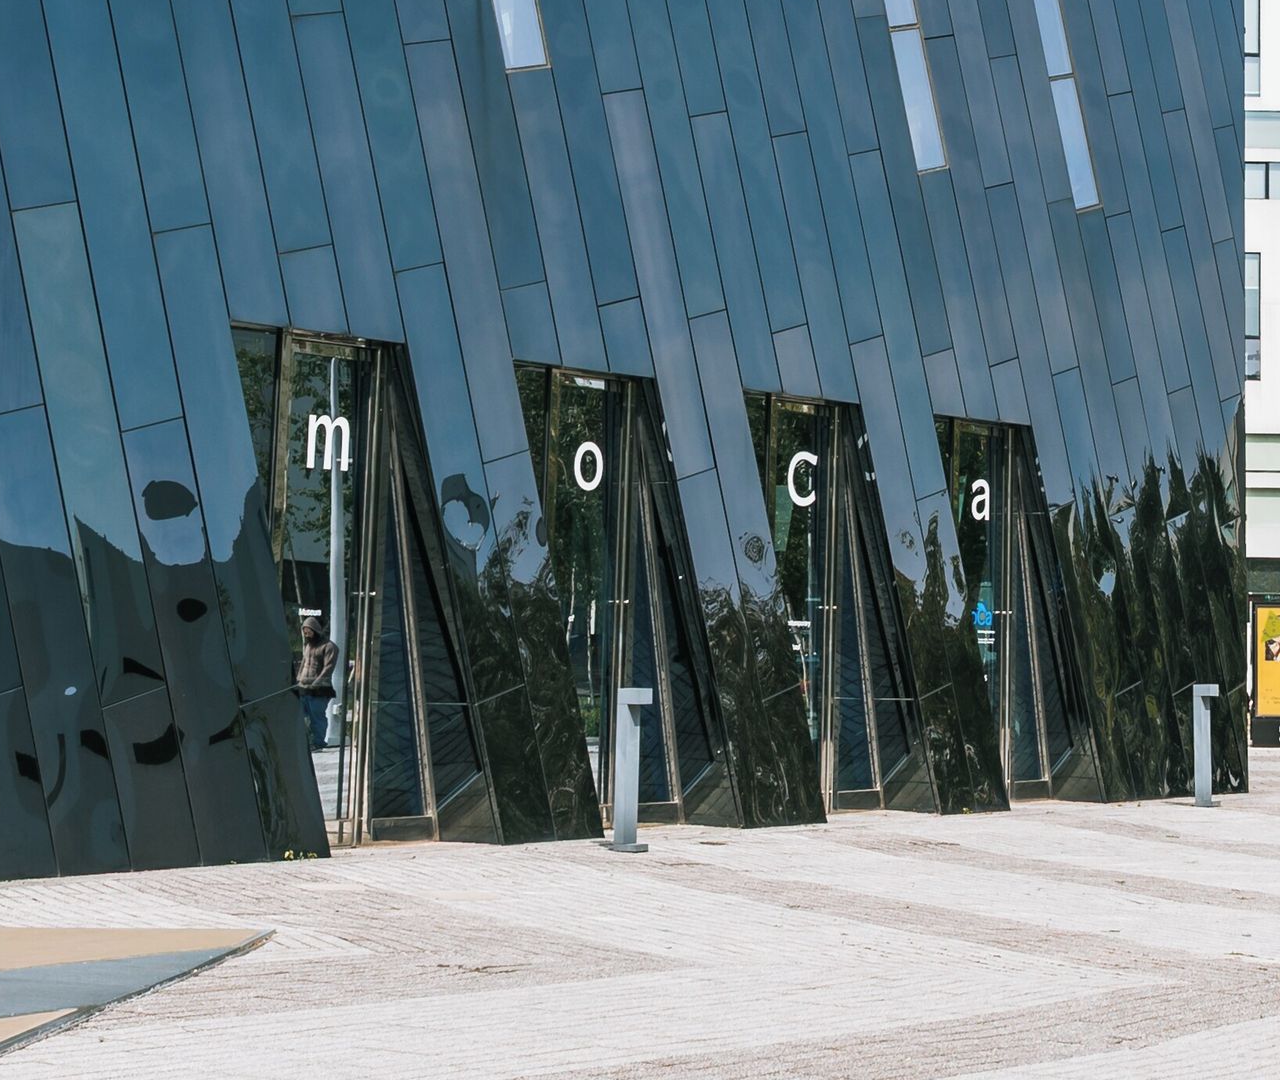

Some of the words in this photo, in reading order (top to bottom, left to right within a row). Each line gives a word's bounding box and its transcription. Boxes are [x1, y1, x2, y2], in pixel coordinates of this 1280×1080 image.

[306, 414, 350, 471] m
[574, 441, 603, 491] o
[971, 479, 990, 520] a
